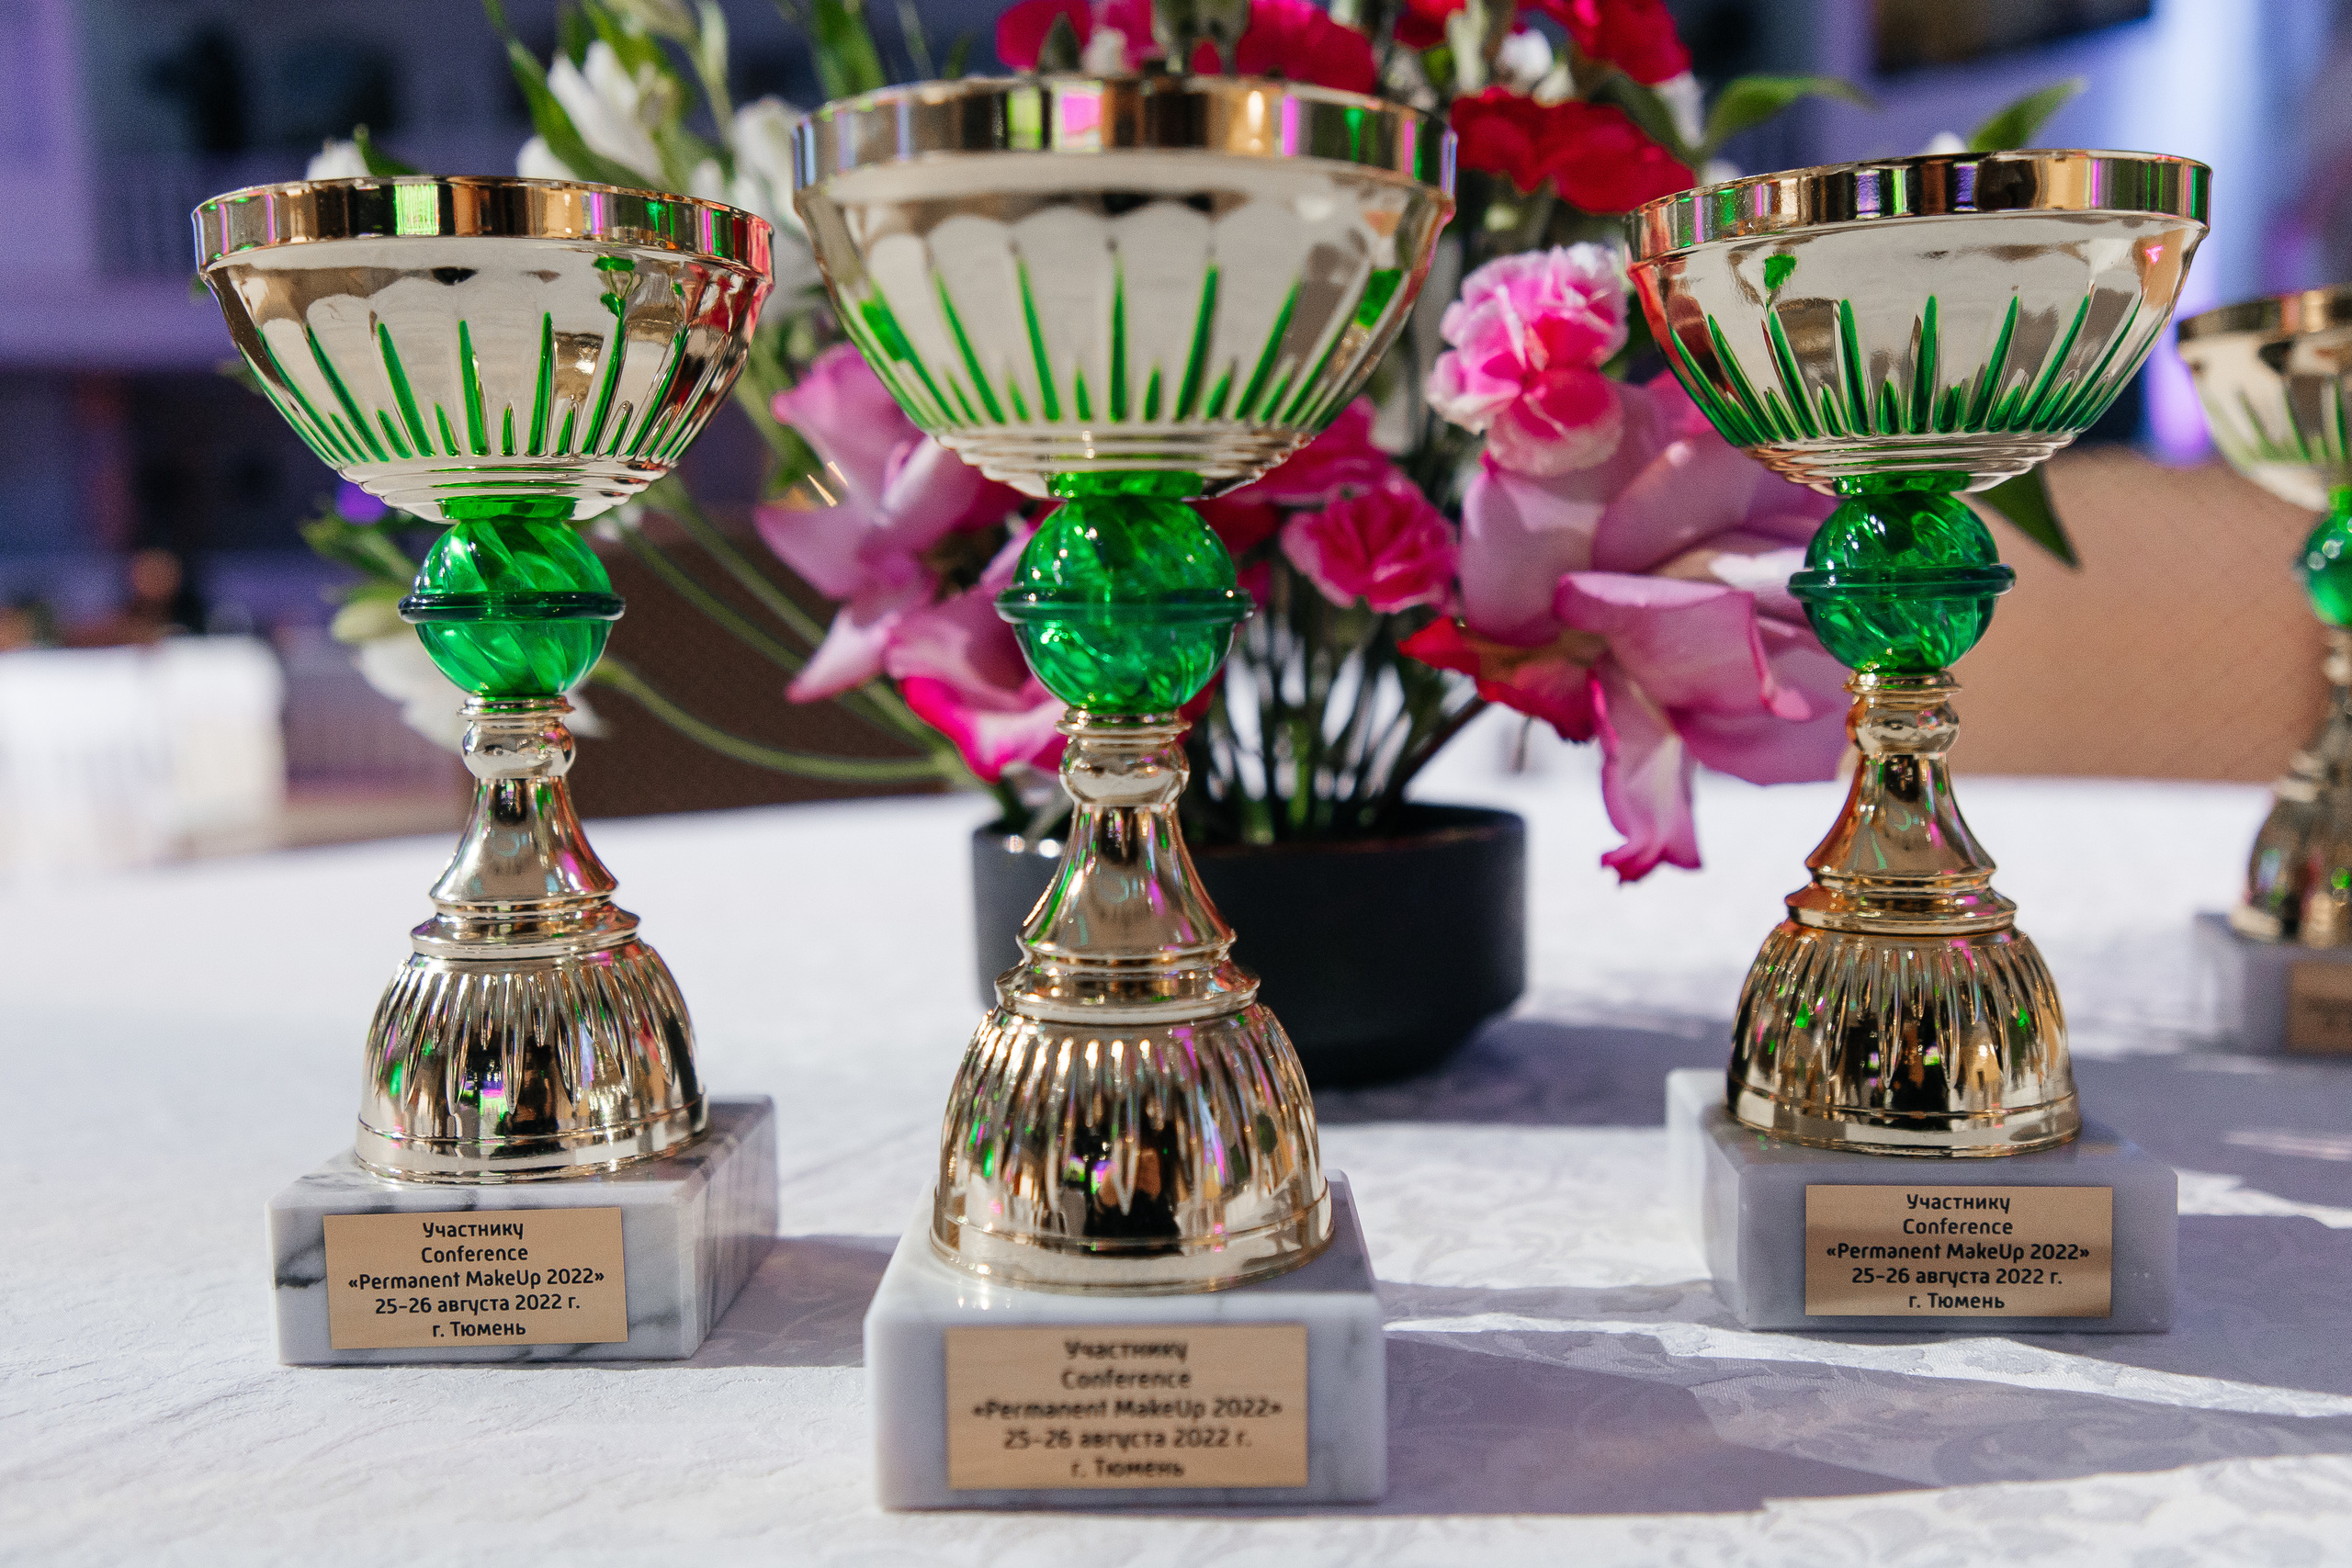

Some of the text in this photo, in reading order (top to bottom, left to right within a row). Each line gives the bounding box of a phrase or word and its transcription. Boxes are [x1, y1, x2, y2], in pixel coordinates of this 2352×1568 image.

[1906, 1193, 2010, 1213] Участнику
[423, 1222, 524, 1239] Участнику
[1903, 1218, 2013, 1235] Conference
[421, 1246, 528, 1263] Conference
[1826, 1243, 2089, 1263] «Permanent MakeUp 2022»
[348, 1268, 605, 1291] «Permanent MakeUp 2022»
[1916, 1269, 1990, 1288] августа
[1996, 1269, 2043, 1284] 2022
[2051, 1272, 2063, 1284] г.
[437, 1297, 510, 1315] августа
[515, 1293, 562, 1311] 2022
[568, 1296, 580, 1309] г.
[1908, 1292, 2005, 1309] г. Тюмень
[433, 1321, 526, 1337] г. Тюмень
[1065, 1340, 1188, 1363] Участнику
[1060, 1366, 1191, 1390] Conference
[1114, 1398, 1206, 1422] MakeUp
[1080, 1430, 1166, 1451] августа
[1173, 1428, 1228, 1448] 2022
[1236, 1431, 1251, 1447] г.
[1070, 1458, 1184, 1477] г. Тюмень
